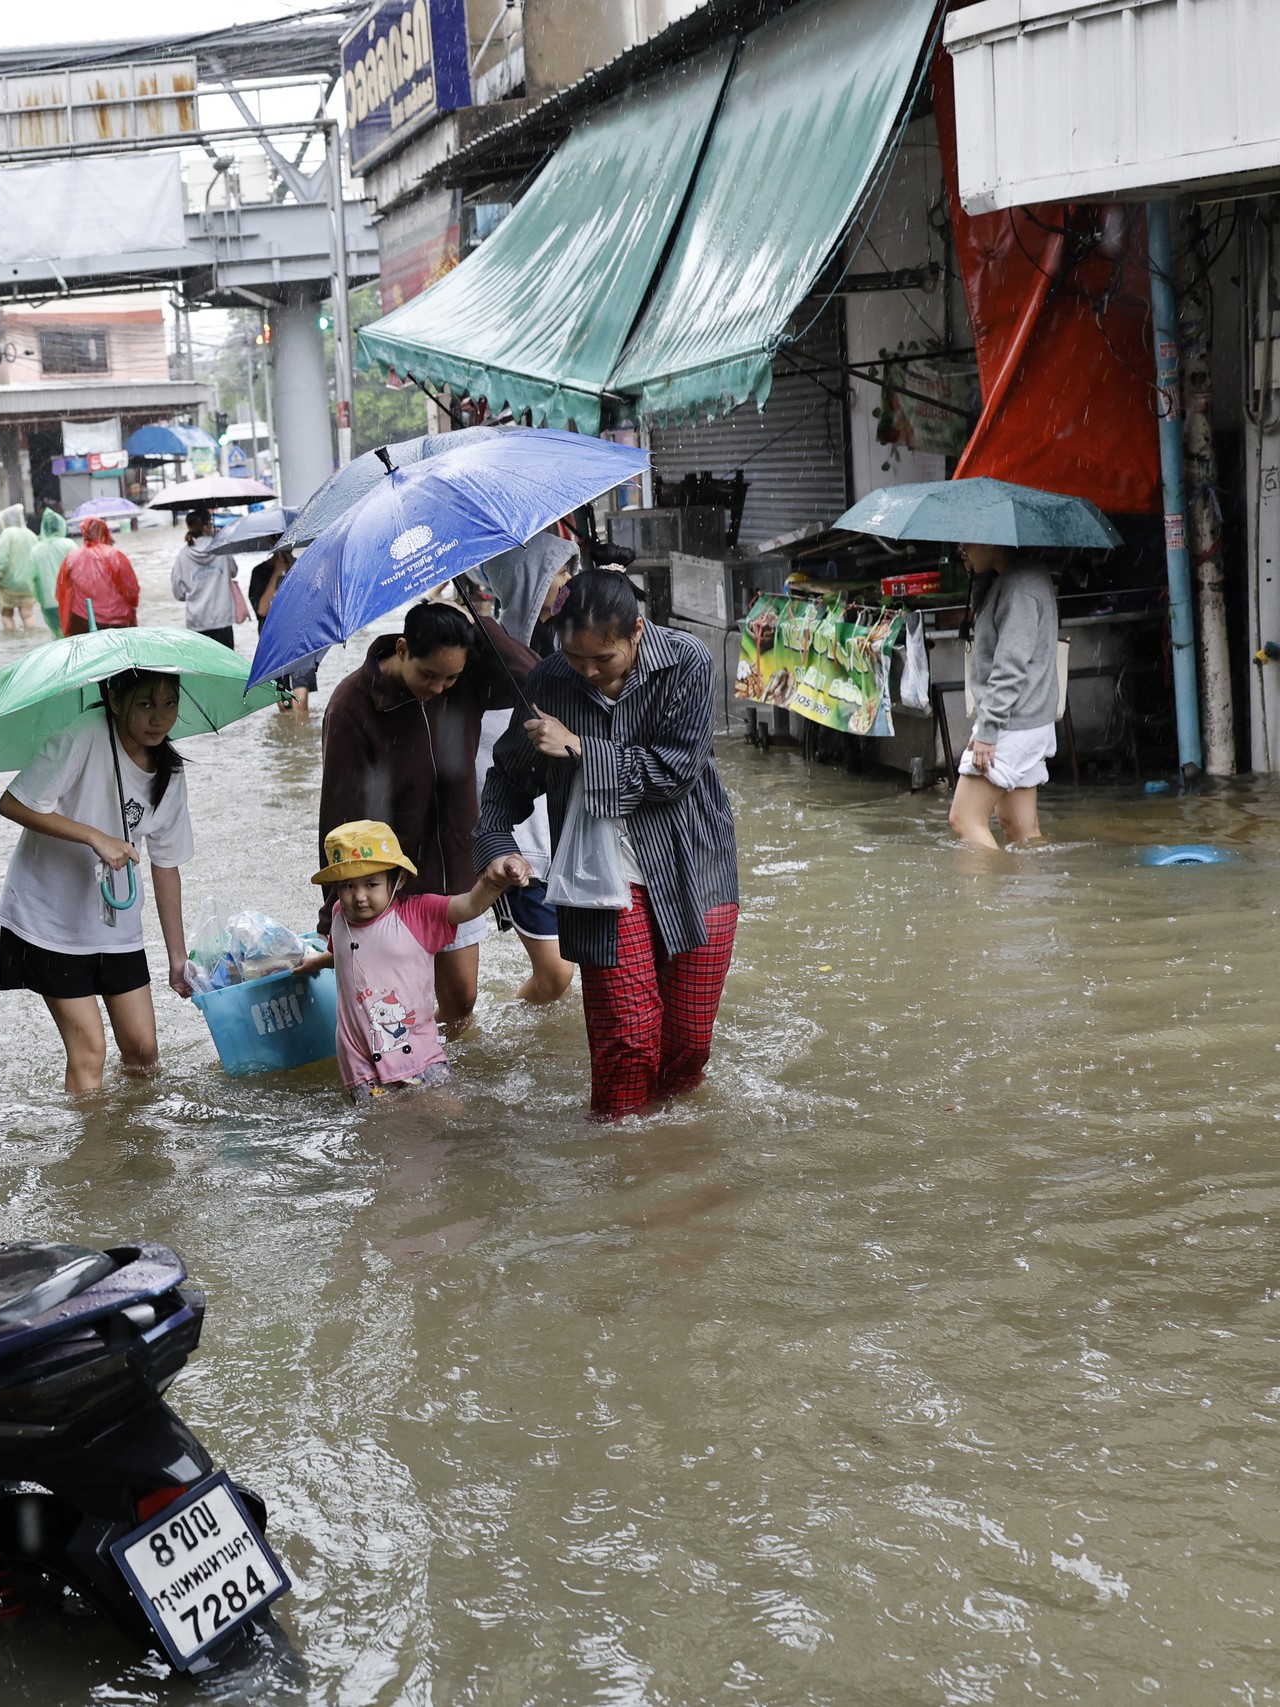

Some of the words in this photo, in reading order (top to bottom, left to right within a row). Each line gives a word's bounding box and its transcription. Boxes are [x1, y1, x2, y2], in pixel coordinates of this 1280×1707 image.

[149, 1501, 221, 1567] 8ขญ
[151, 1531, 254, 1615] กรุงเทพมหานคร
[179, 1564, 267, 1644] 7284
